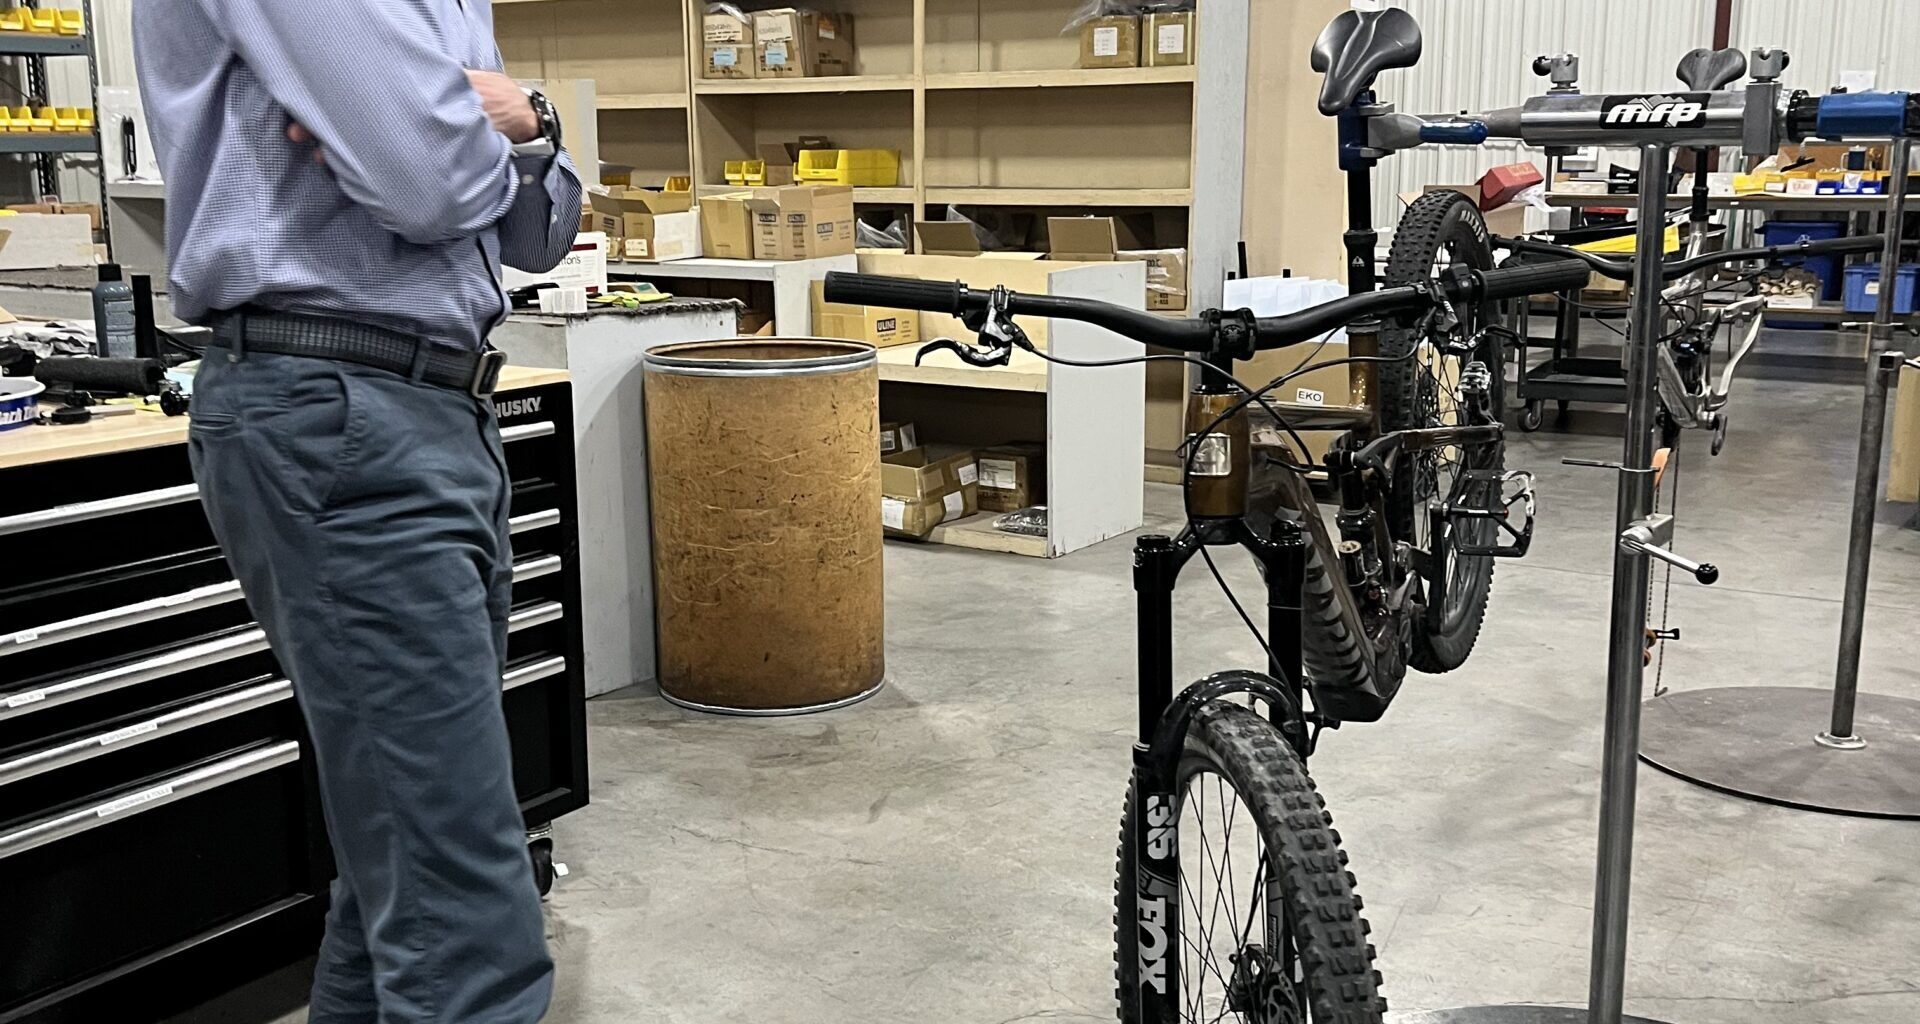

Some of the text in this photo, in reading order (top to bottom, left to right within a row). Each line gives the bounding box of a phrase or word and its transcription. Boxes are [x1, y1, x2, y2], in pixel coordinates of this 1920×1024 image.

[1459, 210, 1485, 243] MAXXIS
[878, 319, 895, 331] ULINE
[1298, 390, 1322, 402] EKO
[1147, 794, 1176, 860] 36
[1138, 897, 1168, 994] FOX
